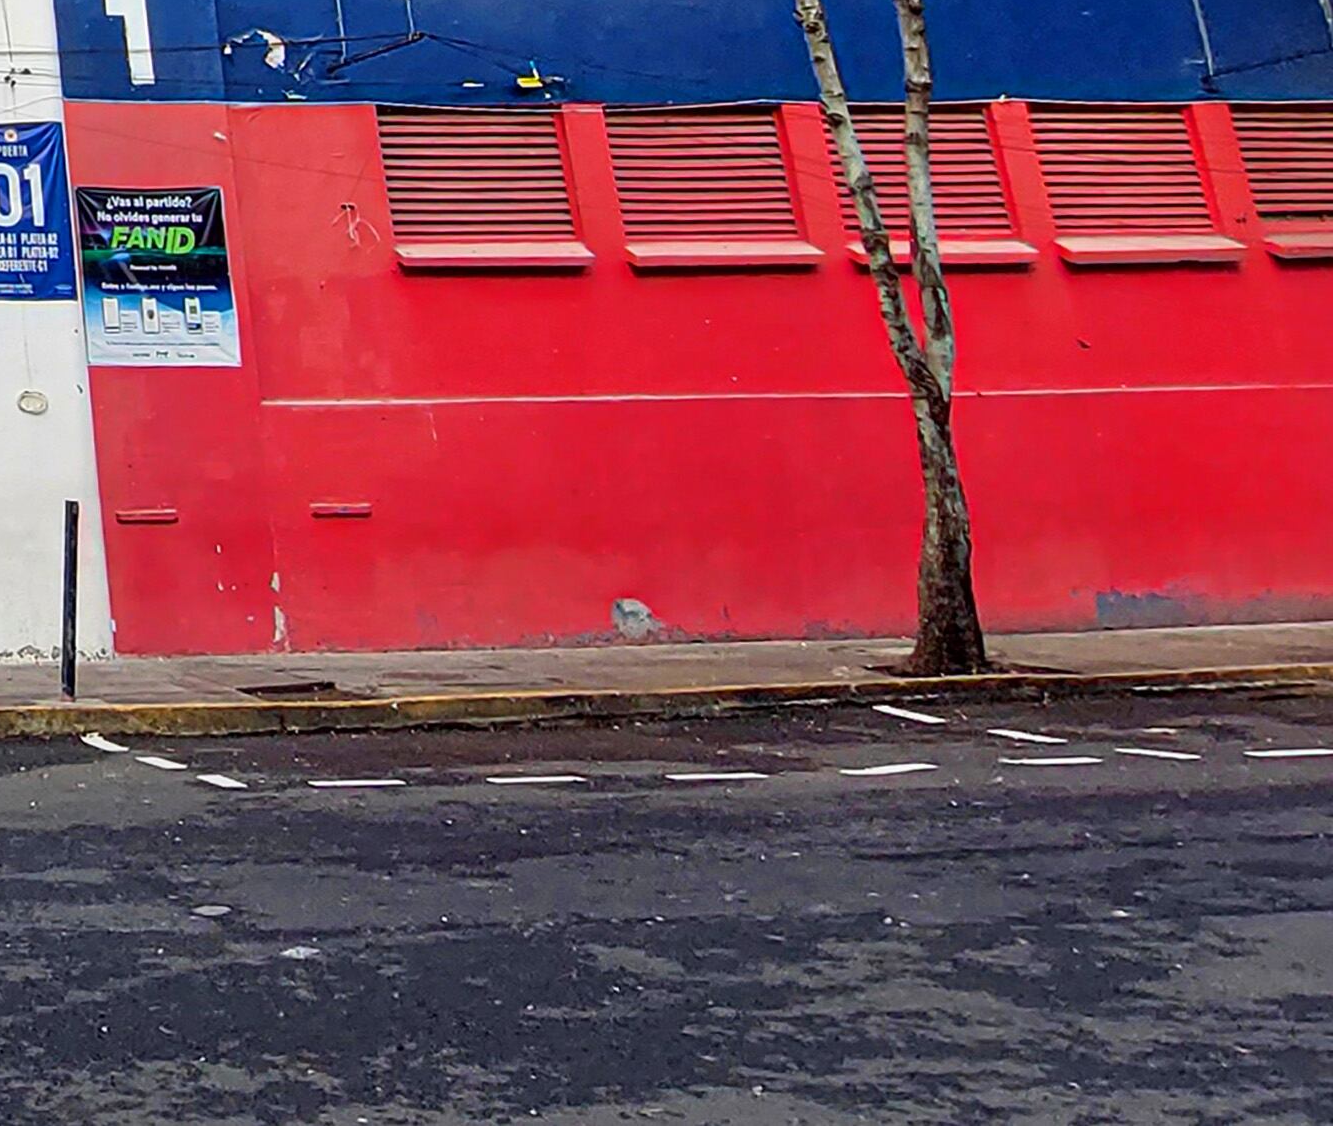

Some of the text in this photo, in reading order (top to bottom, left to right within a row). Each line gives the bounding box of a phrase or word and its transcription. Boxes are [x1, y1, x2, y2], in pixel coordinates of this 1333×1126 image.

[105, 195, 193, 211] ¿Vas al partido?
[96, 210, 112, 223] No
[113, 211, 150, 223] olvides
[191, 212, 203, 223] tu
